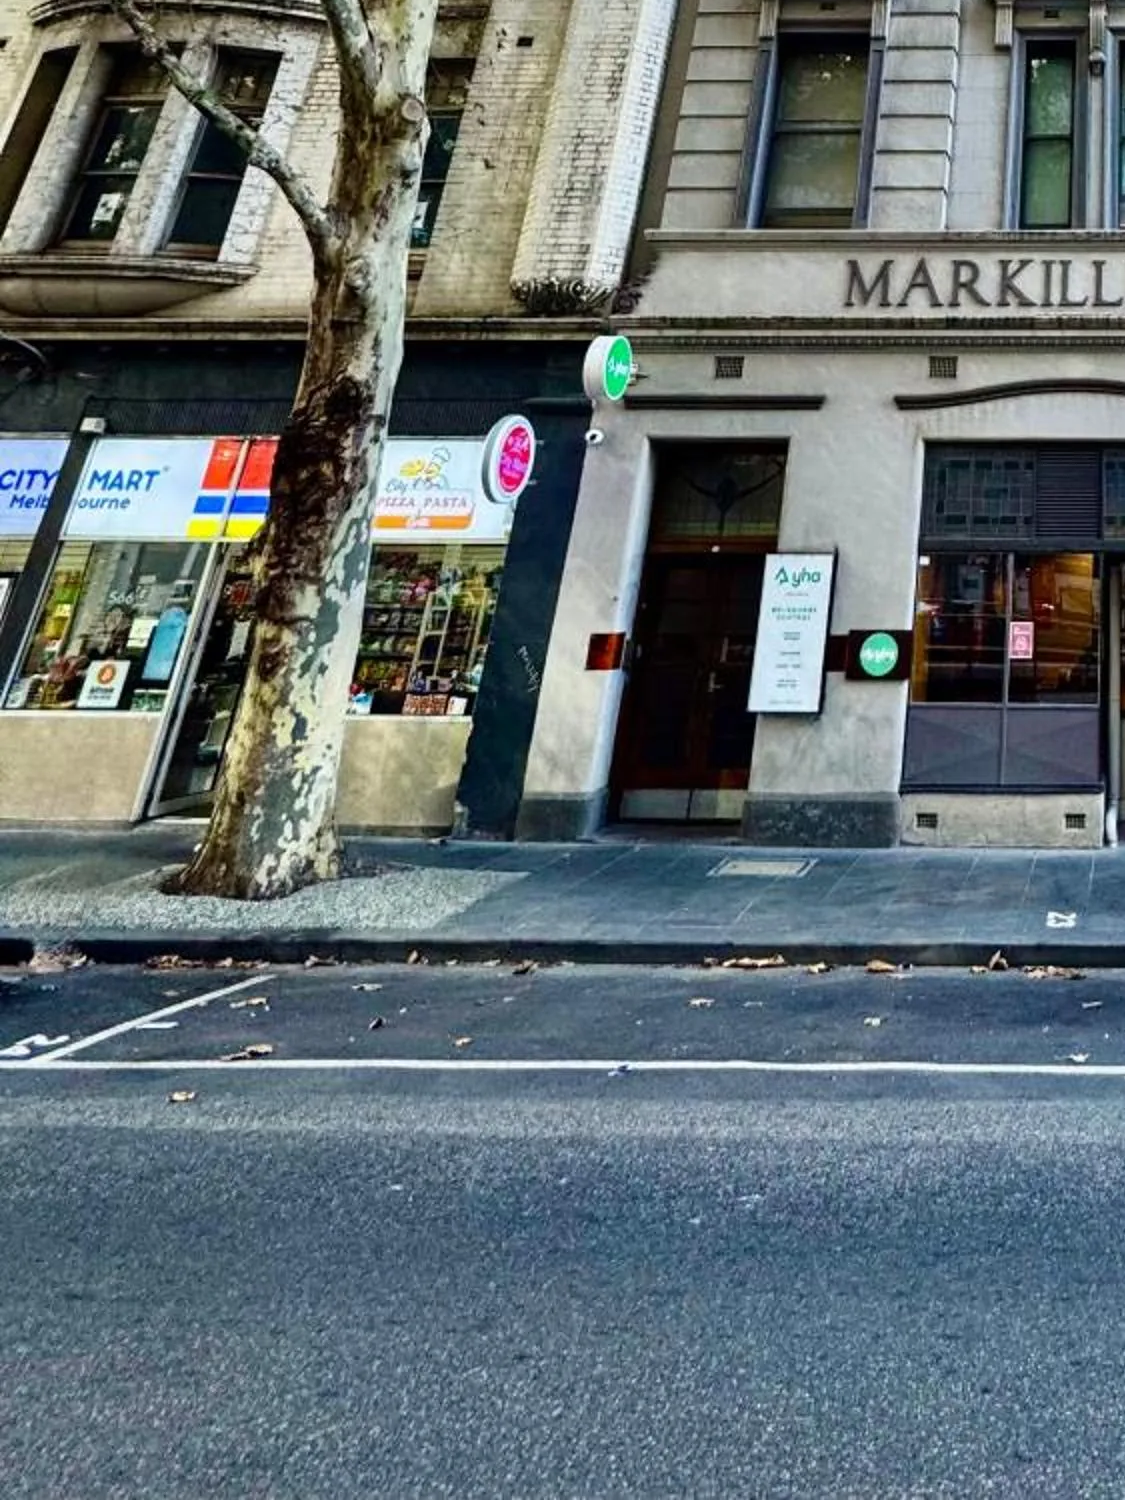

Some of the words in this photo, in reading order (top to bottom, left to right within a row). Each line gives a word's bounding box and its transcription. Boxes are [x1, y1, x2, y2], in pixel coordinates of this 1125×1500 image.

[0, 469, 61, 491] CITY
[87, 469, 160, 492] MART
[423, 496, 468, 509] PASTA
[791, 566, 821, 588] yha
